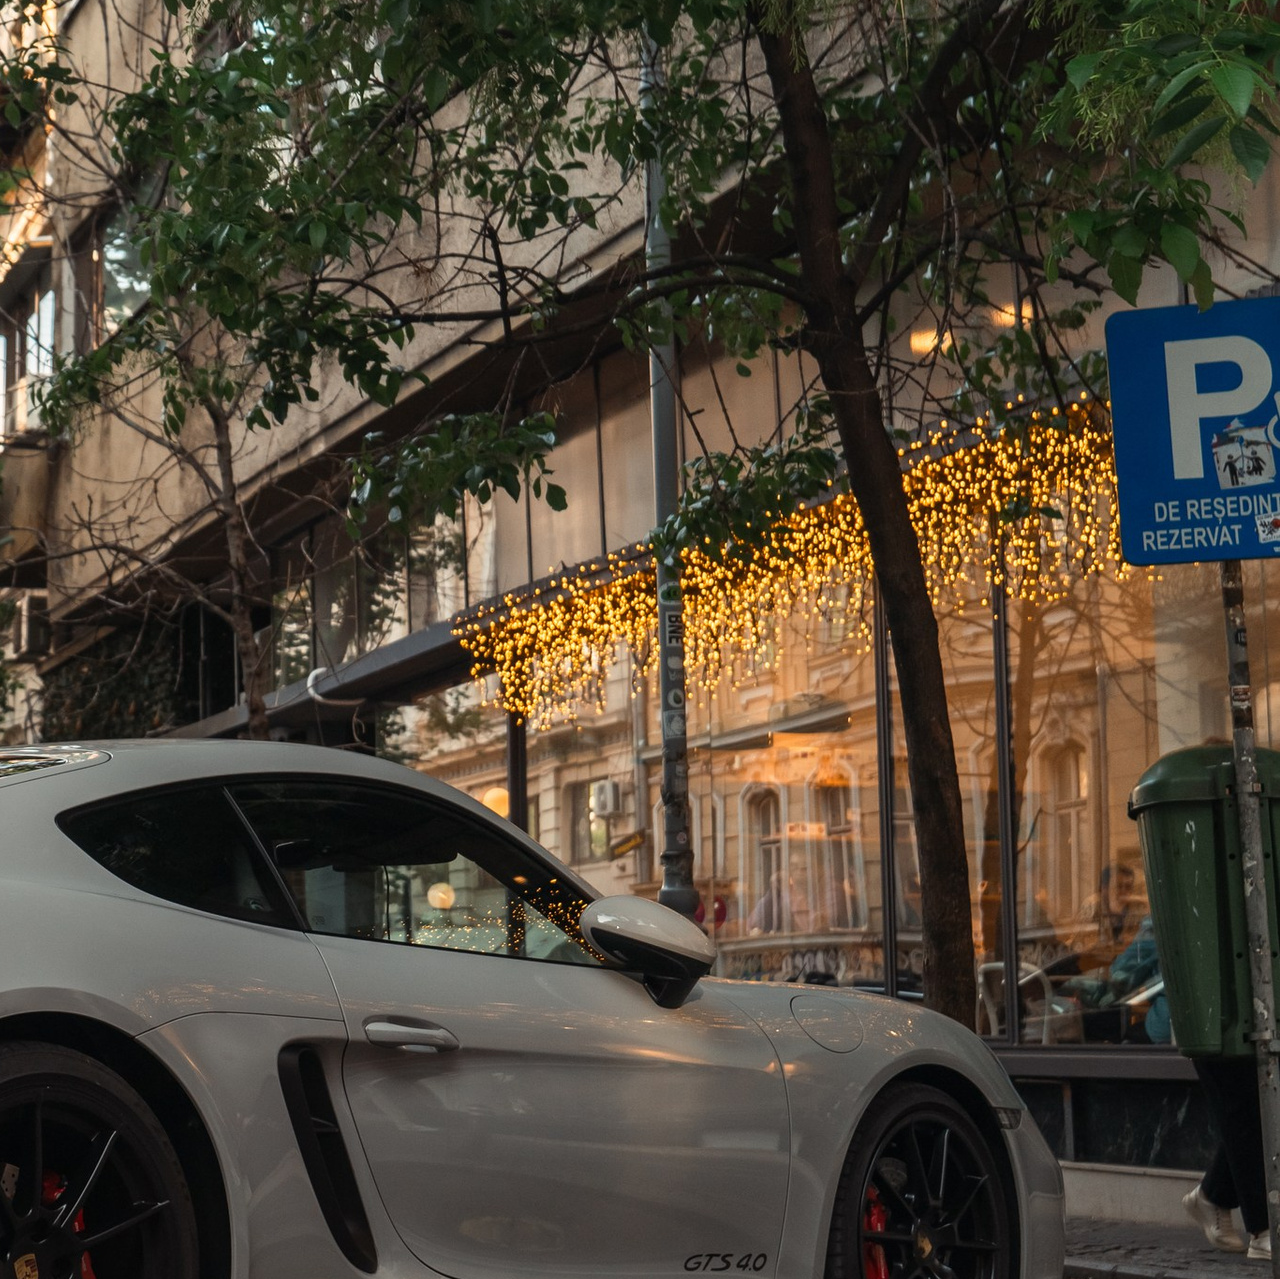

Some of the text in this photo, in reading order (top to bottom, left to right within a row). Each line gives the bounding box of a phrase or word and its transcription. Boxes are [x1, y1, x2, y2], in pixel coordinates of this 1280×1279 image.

[1164, 335, 1273, 480] P
[1154, 500, 1181, 523] DE
[1142, 524, 1242, 552] REZERVAT
[683, 1253, 768, 1272] GTS 4.0
